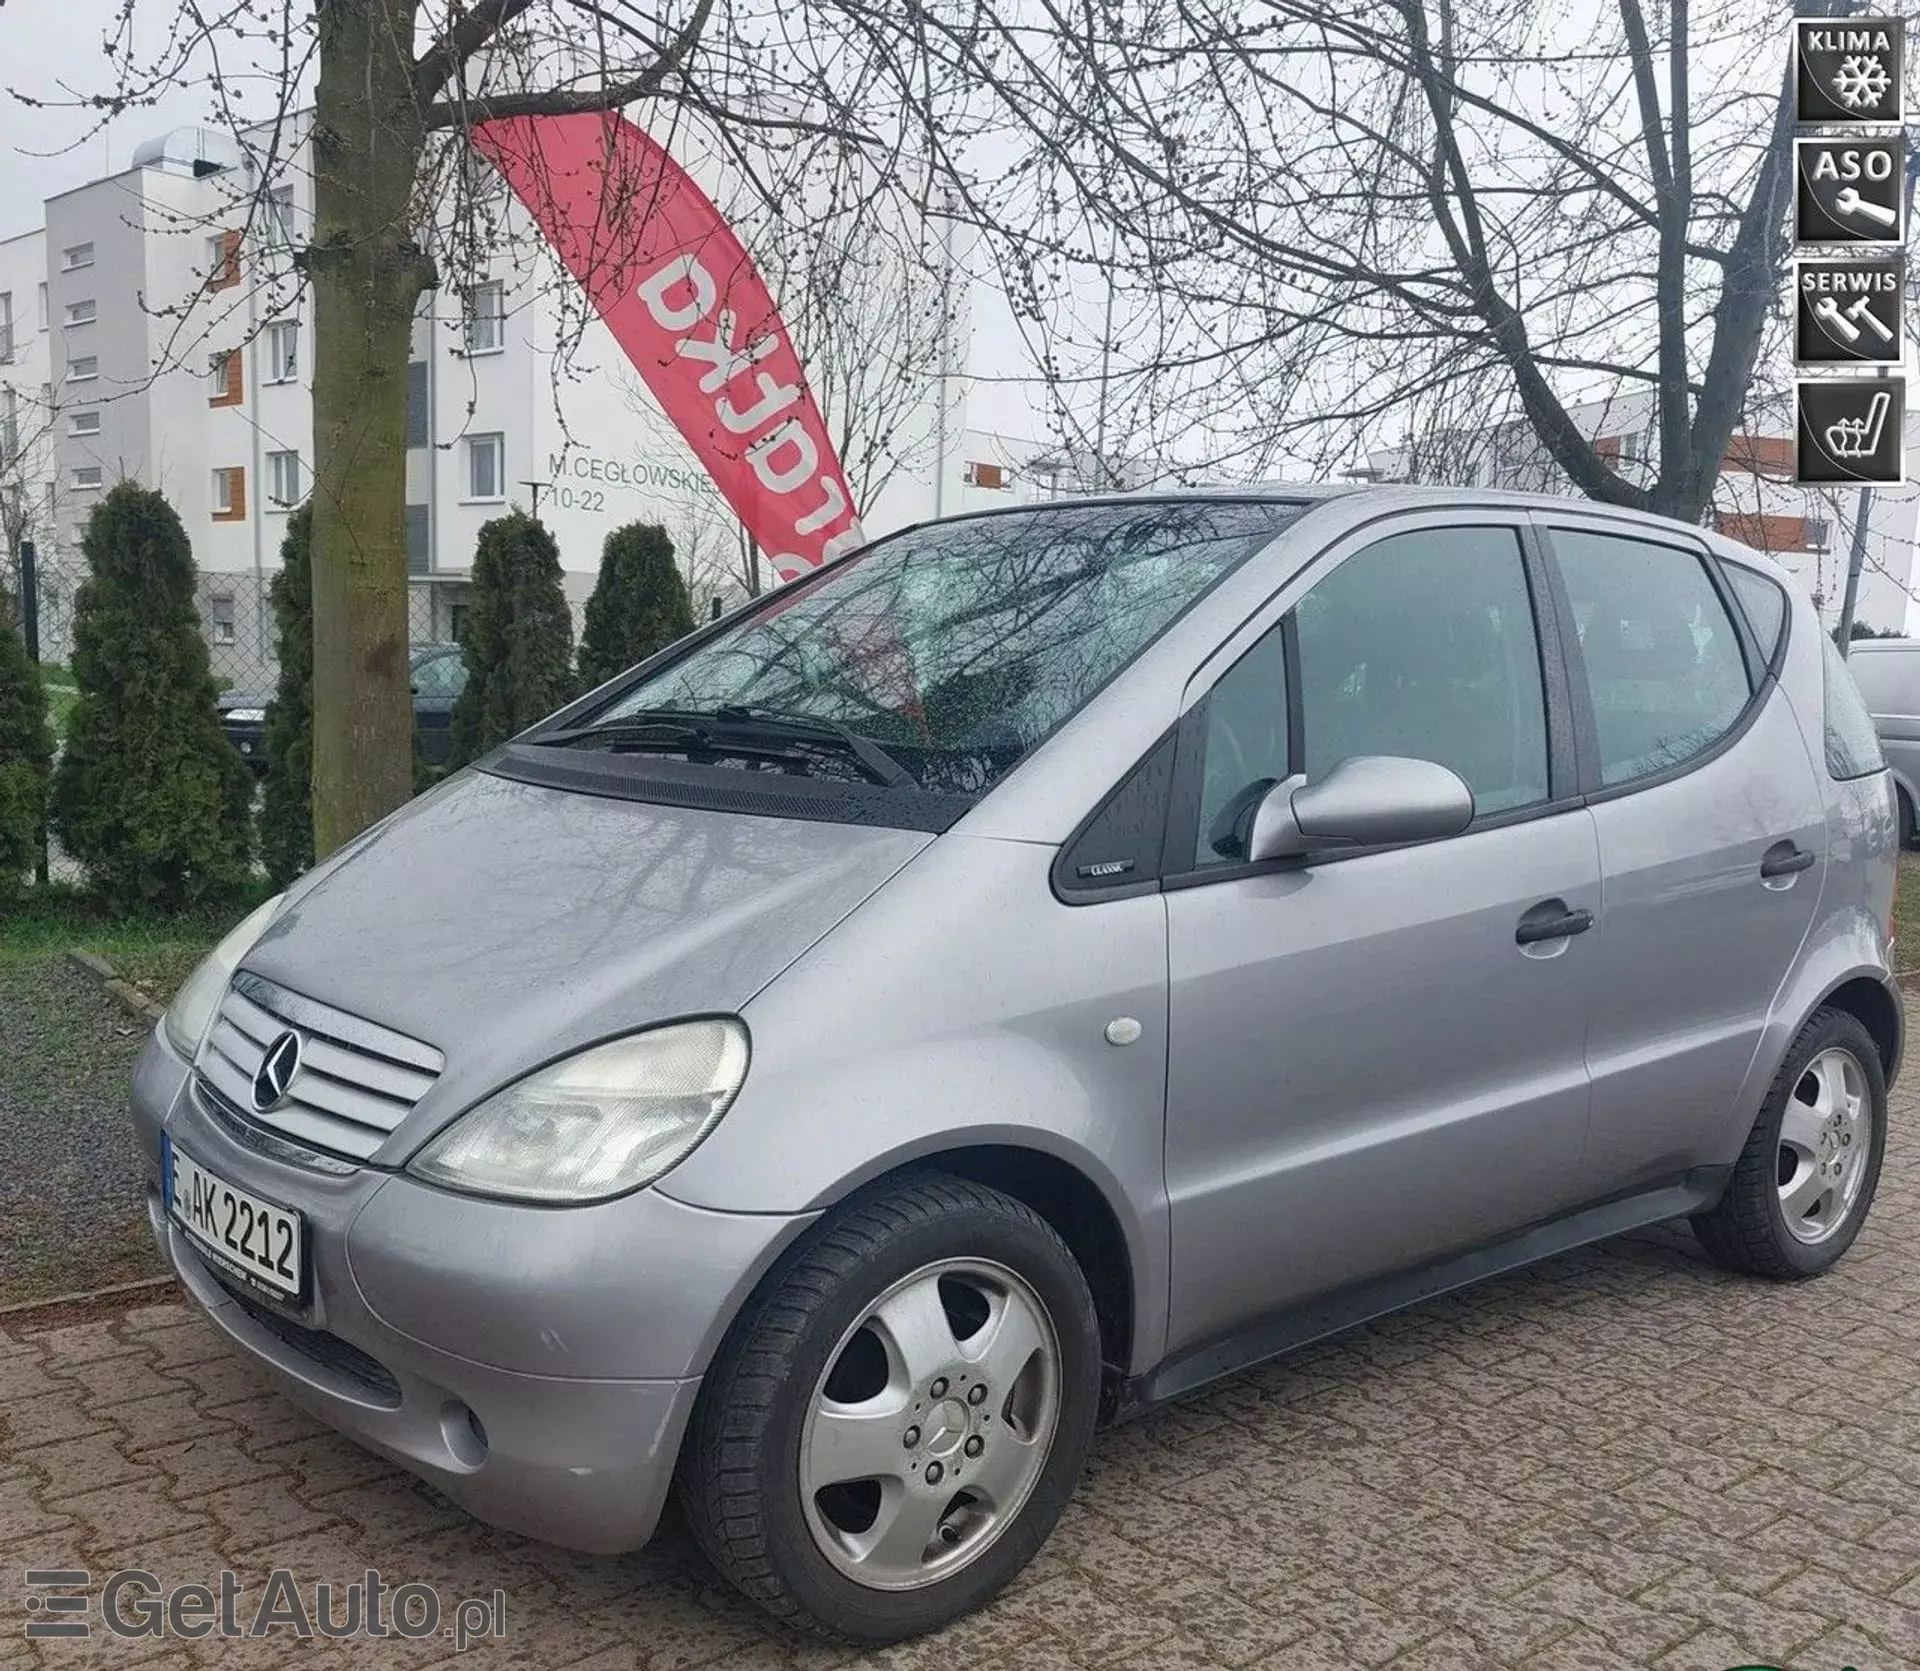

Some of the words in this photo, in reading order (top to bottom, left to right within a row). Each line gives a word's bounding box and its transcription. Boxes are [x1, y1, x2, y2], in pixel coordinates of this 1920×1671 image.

[552, 487, 605, 513] 10-22
[193, 1170, 219, 1238] AK
[223, 1191, 294, 1281] 2212
